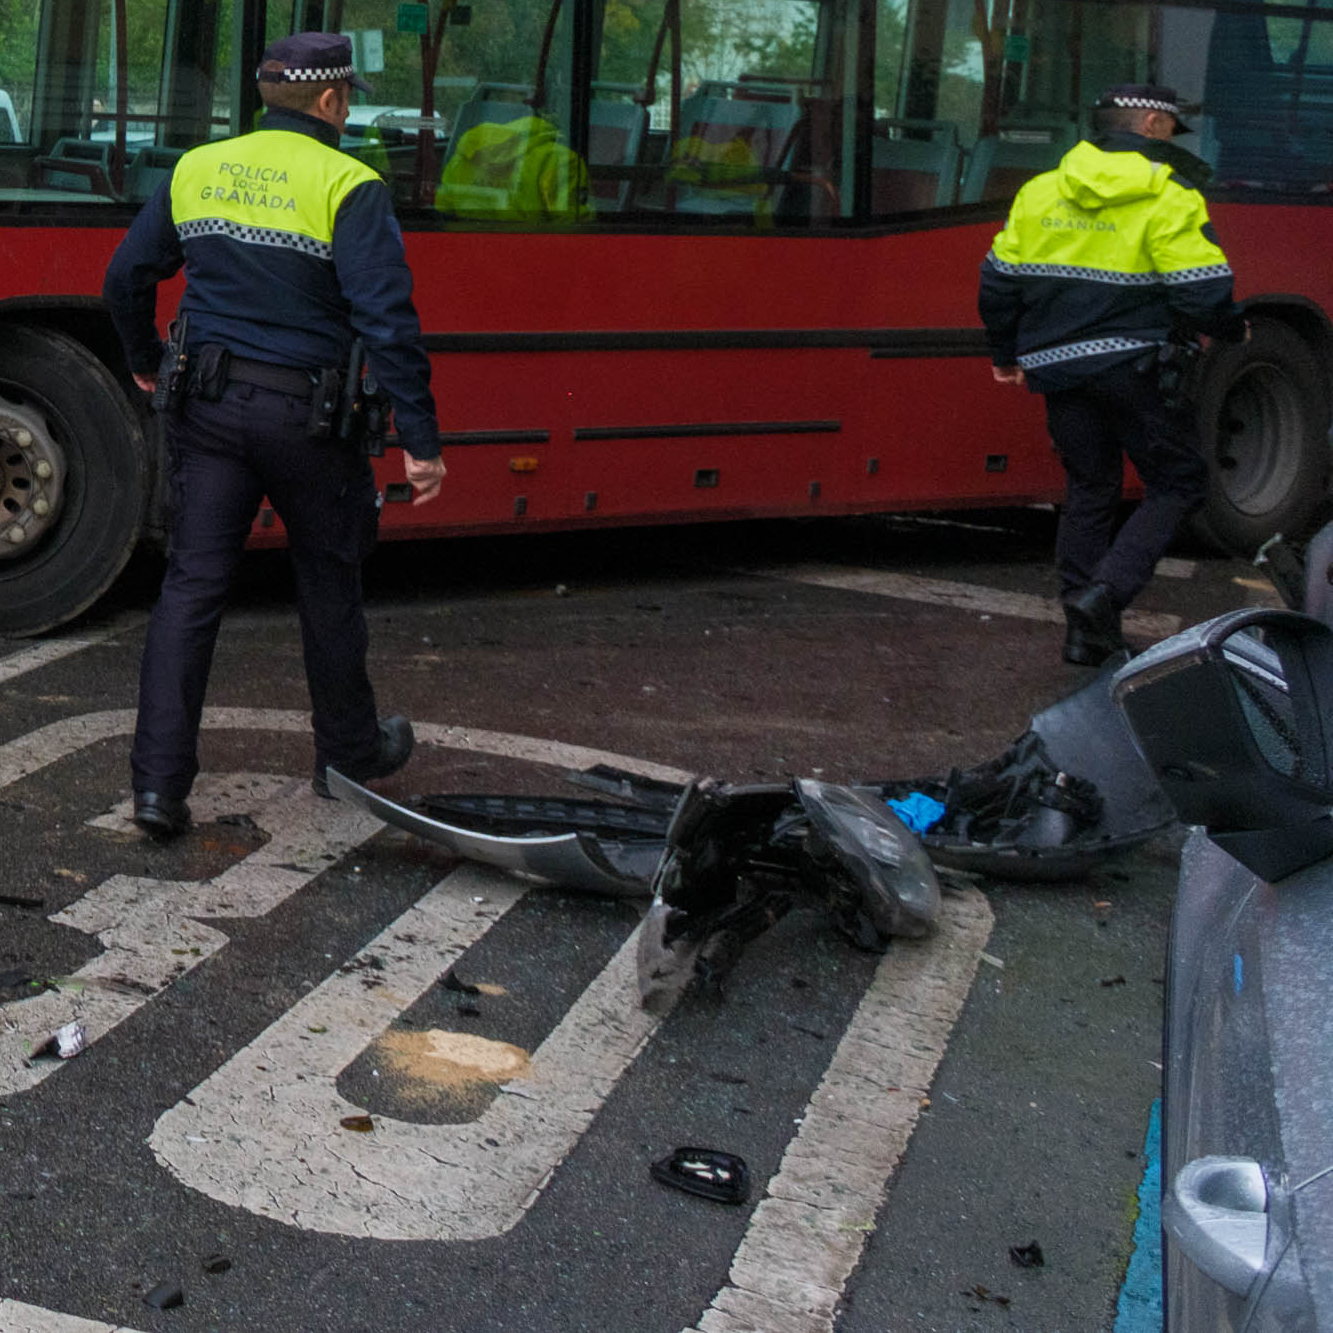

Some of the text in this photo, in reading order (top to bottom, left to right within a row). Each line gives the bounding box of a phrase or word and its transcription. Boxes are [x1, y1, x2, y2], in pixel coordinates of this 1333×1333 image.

[218, 162, 288, 184] POLICIA
[232, 178, 269, 192] LOCAL
[200, 186, 296, 212] GRANADA
[1041, 217, 1116, 233] GRANDA
